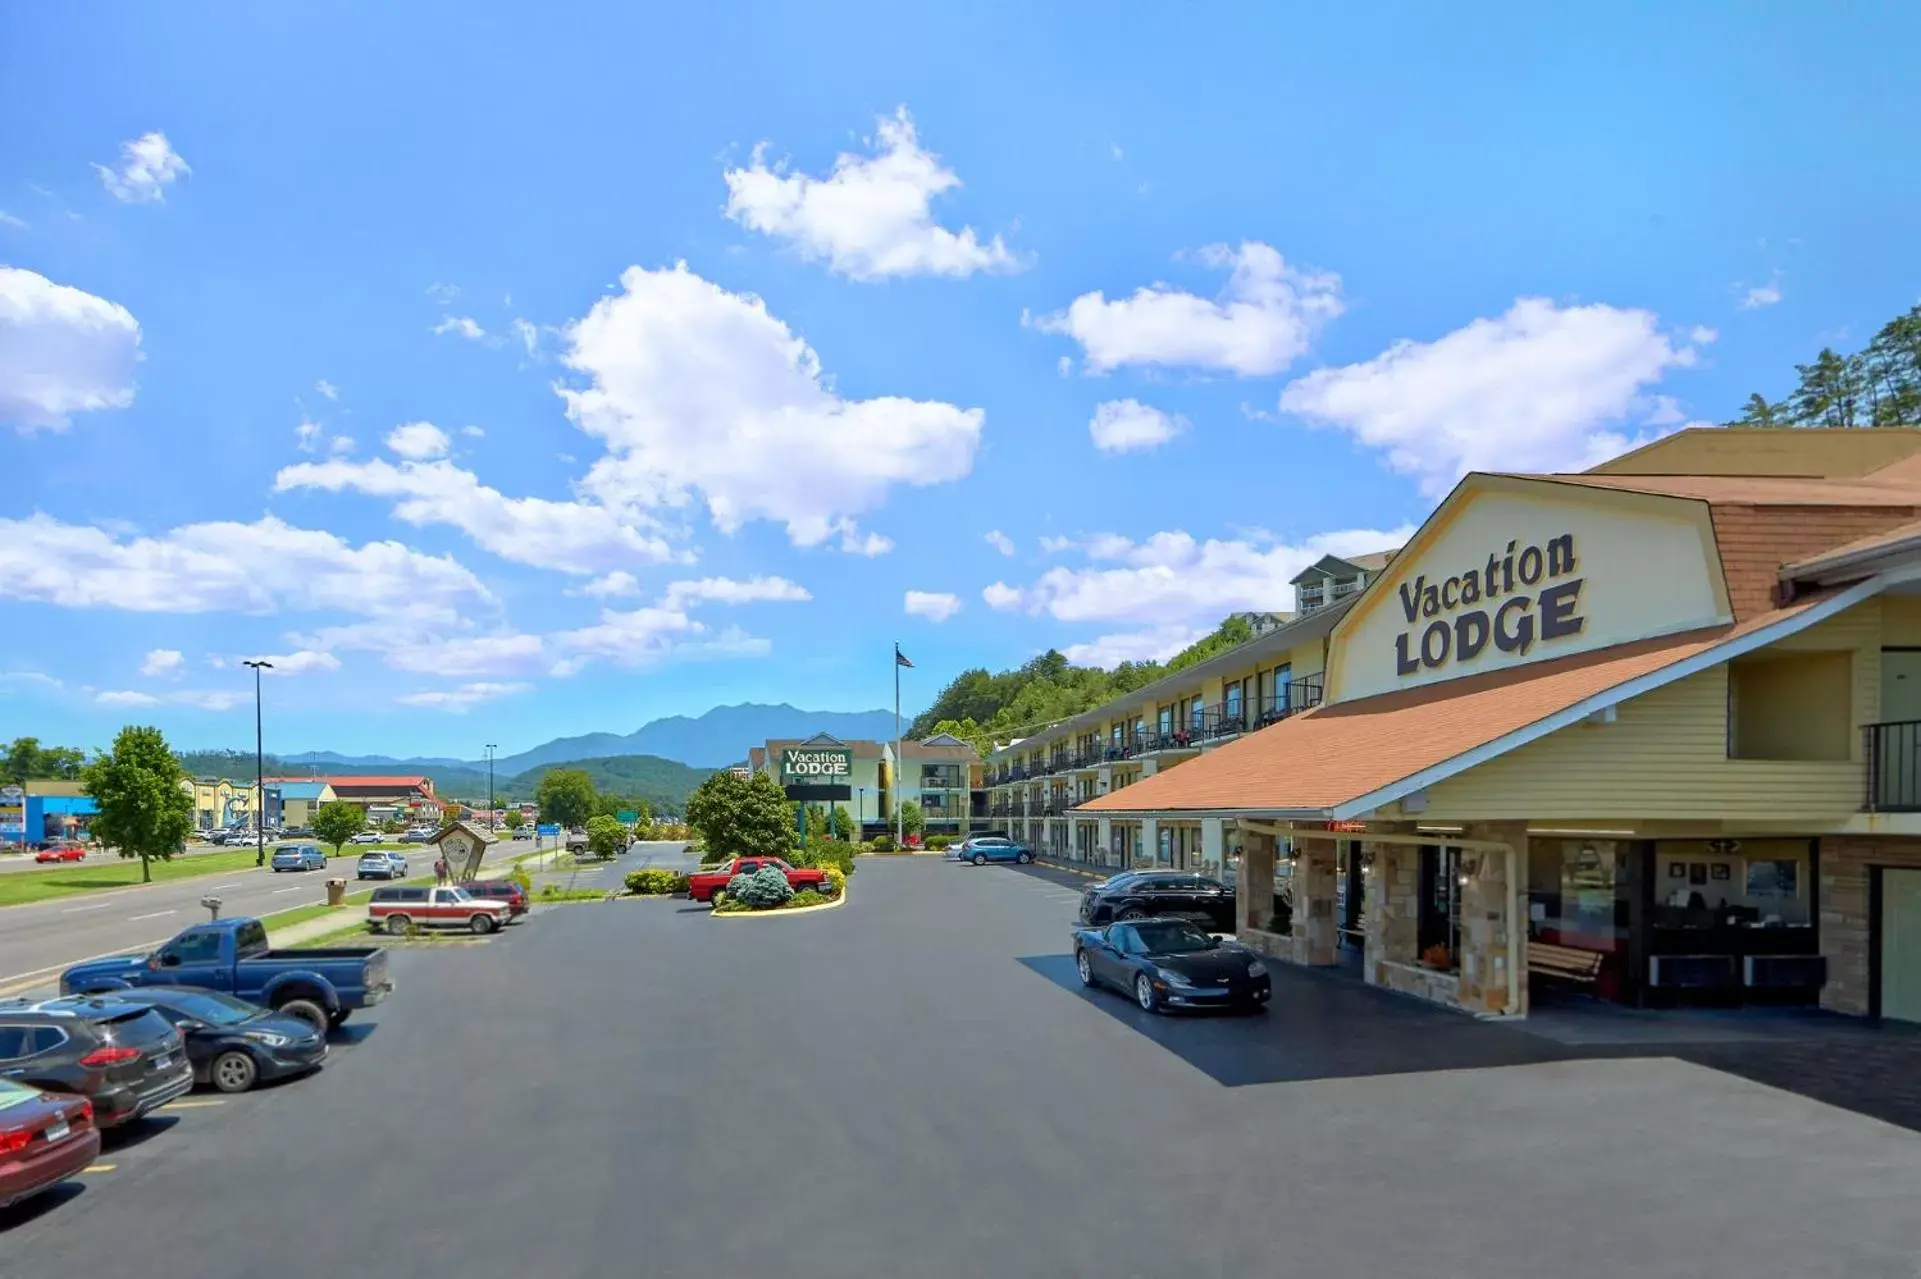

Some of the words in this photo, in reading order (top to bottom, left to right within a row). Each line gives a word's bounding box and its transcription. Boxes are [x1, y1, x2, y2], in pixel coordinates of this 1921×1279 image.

[1398, 533, 1577, 623] Vacation
[1394, 578, 1585, 676] LODGE
[785, 762, 849, 775] LODGE
[787, 750, 846, 762] Vacation
